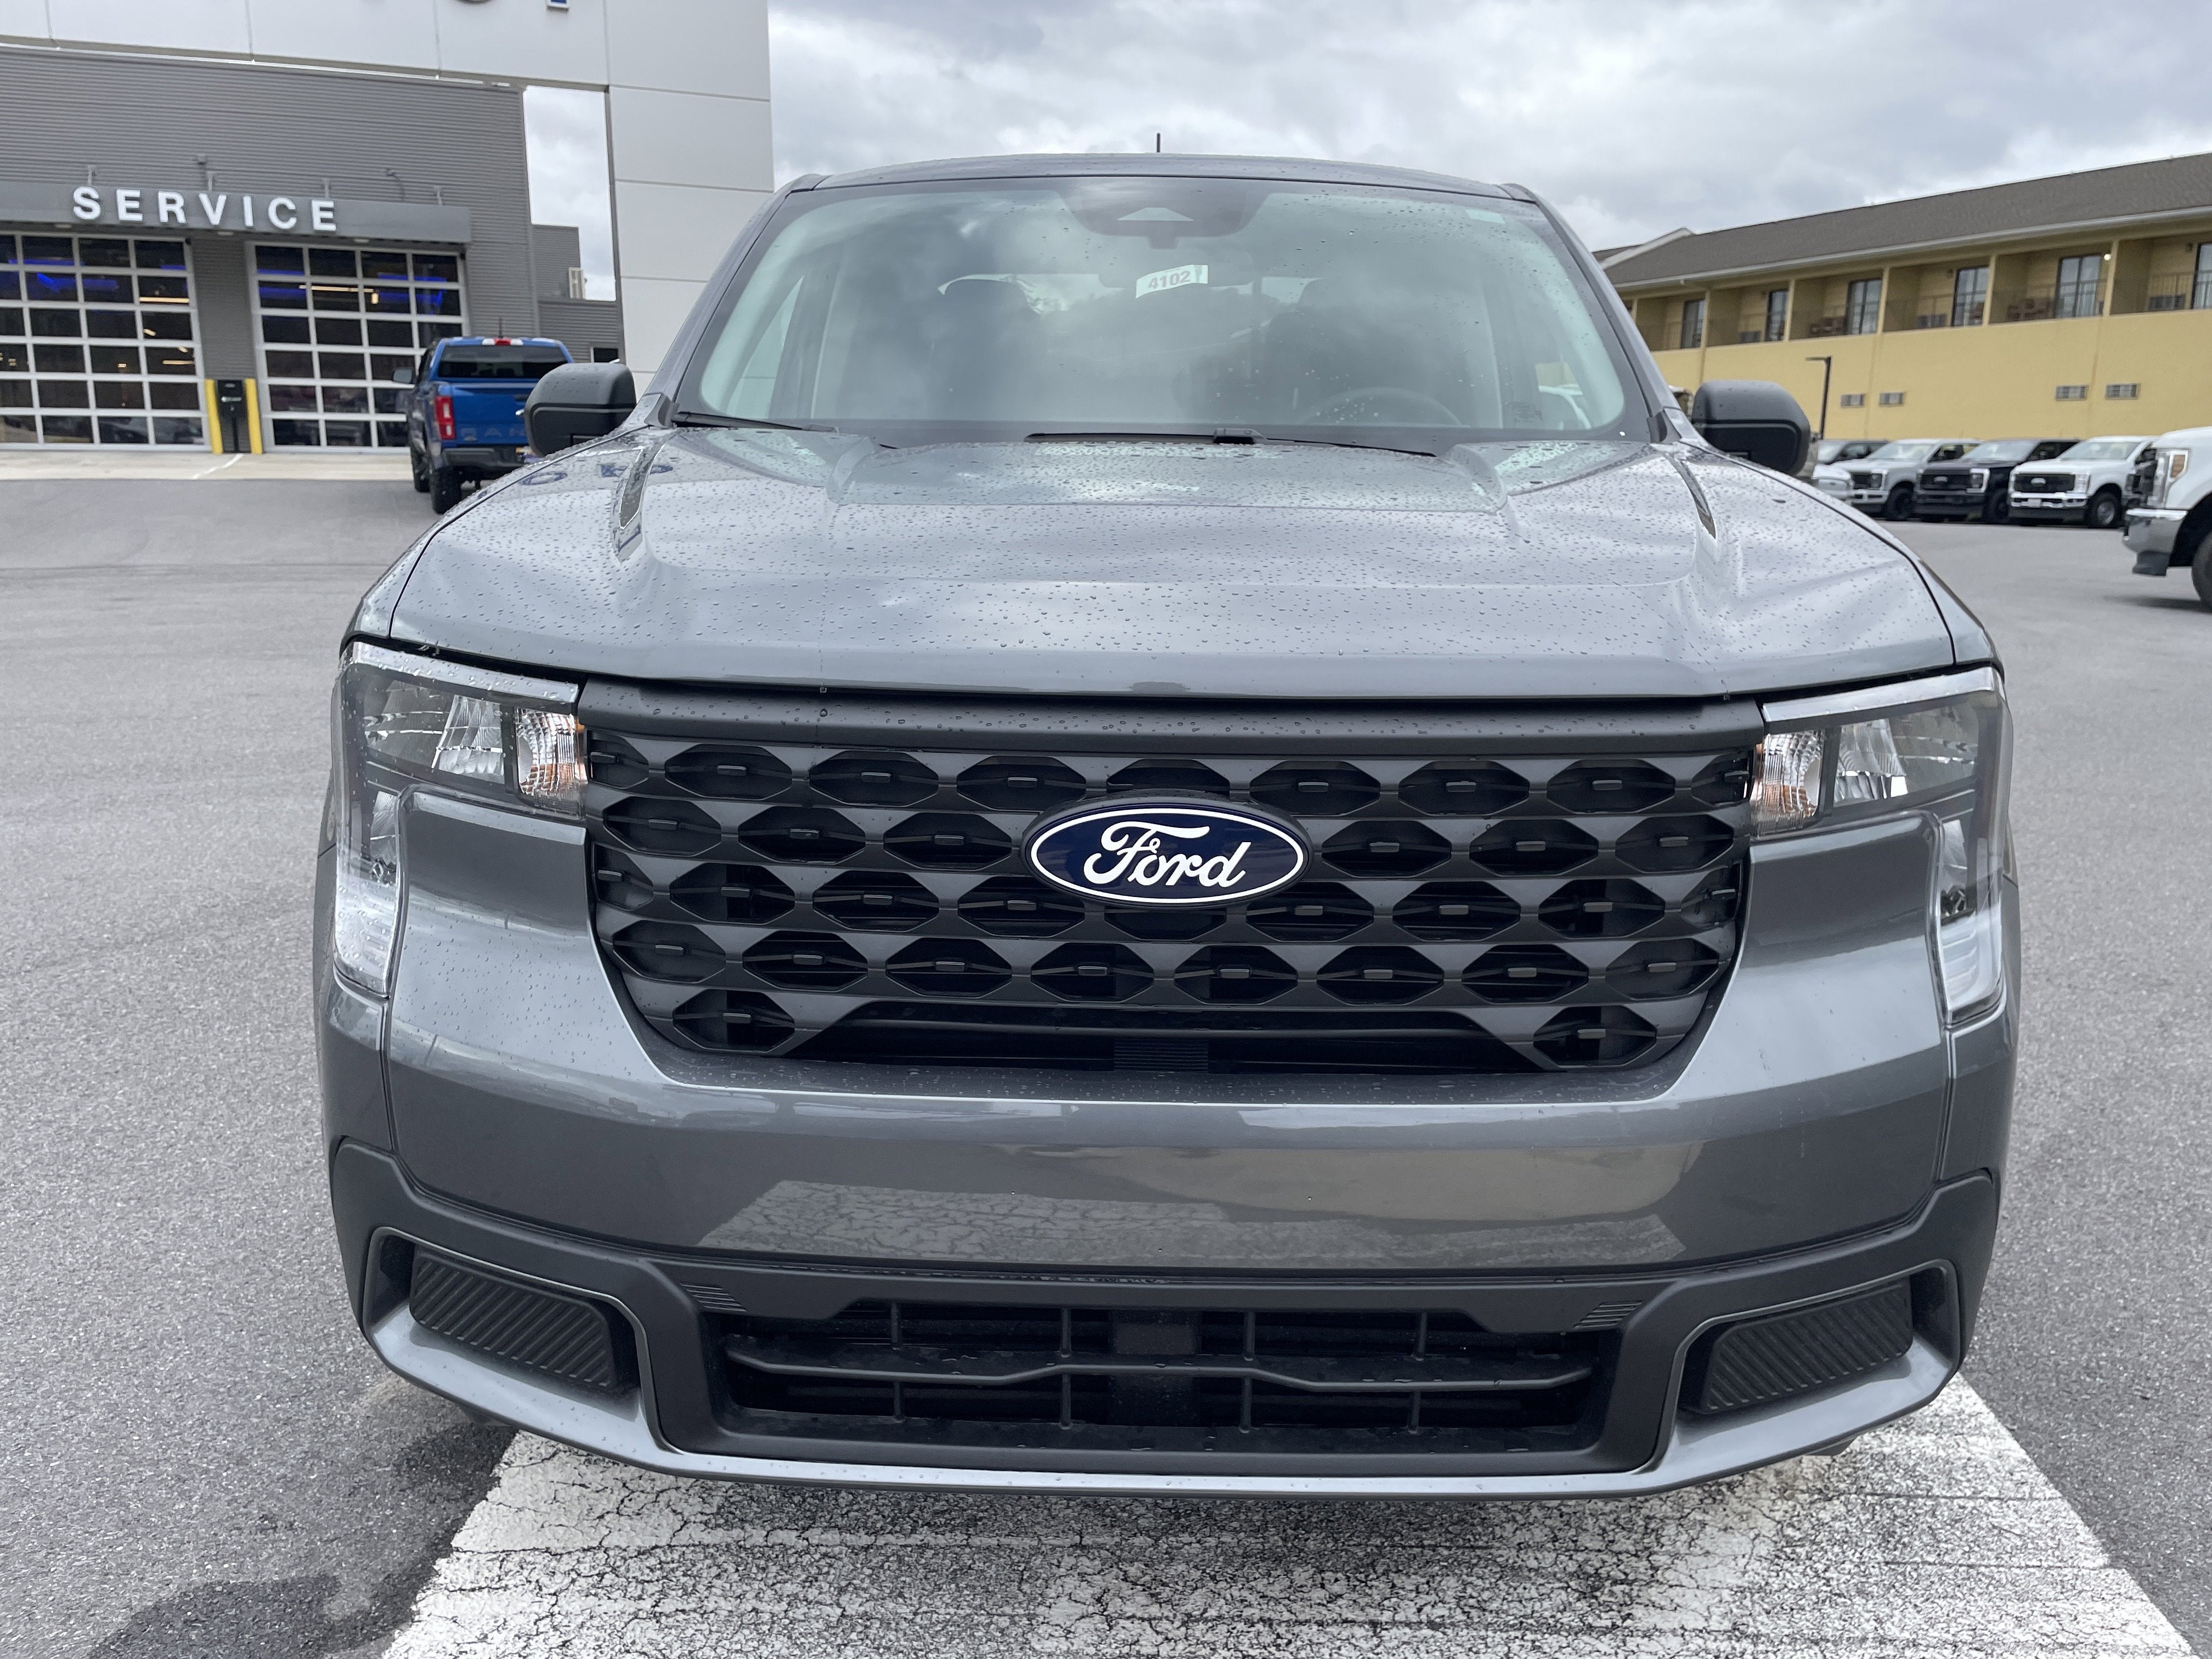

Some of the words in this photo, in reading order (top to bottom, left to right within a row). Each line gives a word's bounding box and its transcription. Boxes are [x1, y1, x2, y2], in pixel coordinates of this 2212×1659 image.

[73, 186, 338, 232] SERVICE
[1148, 270, 1191, 289] 4102
[1083, 821, 1252, 888] Ford
